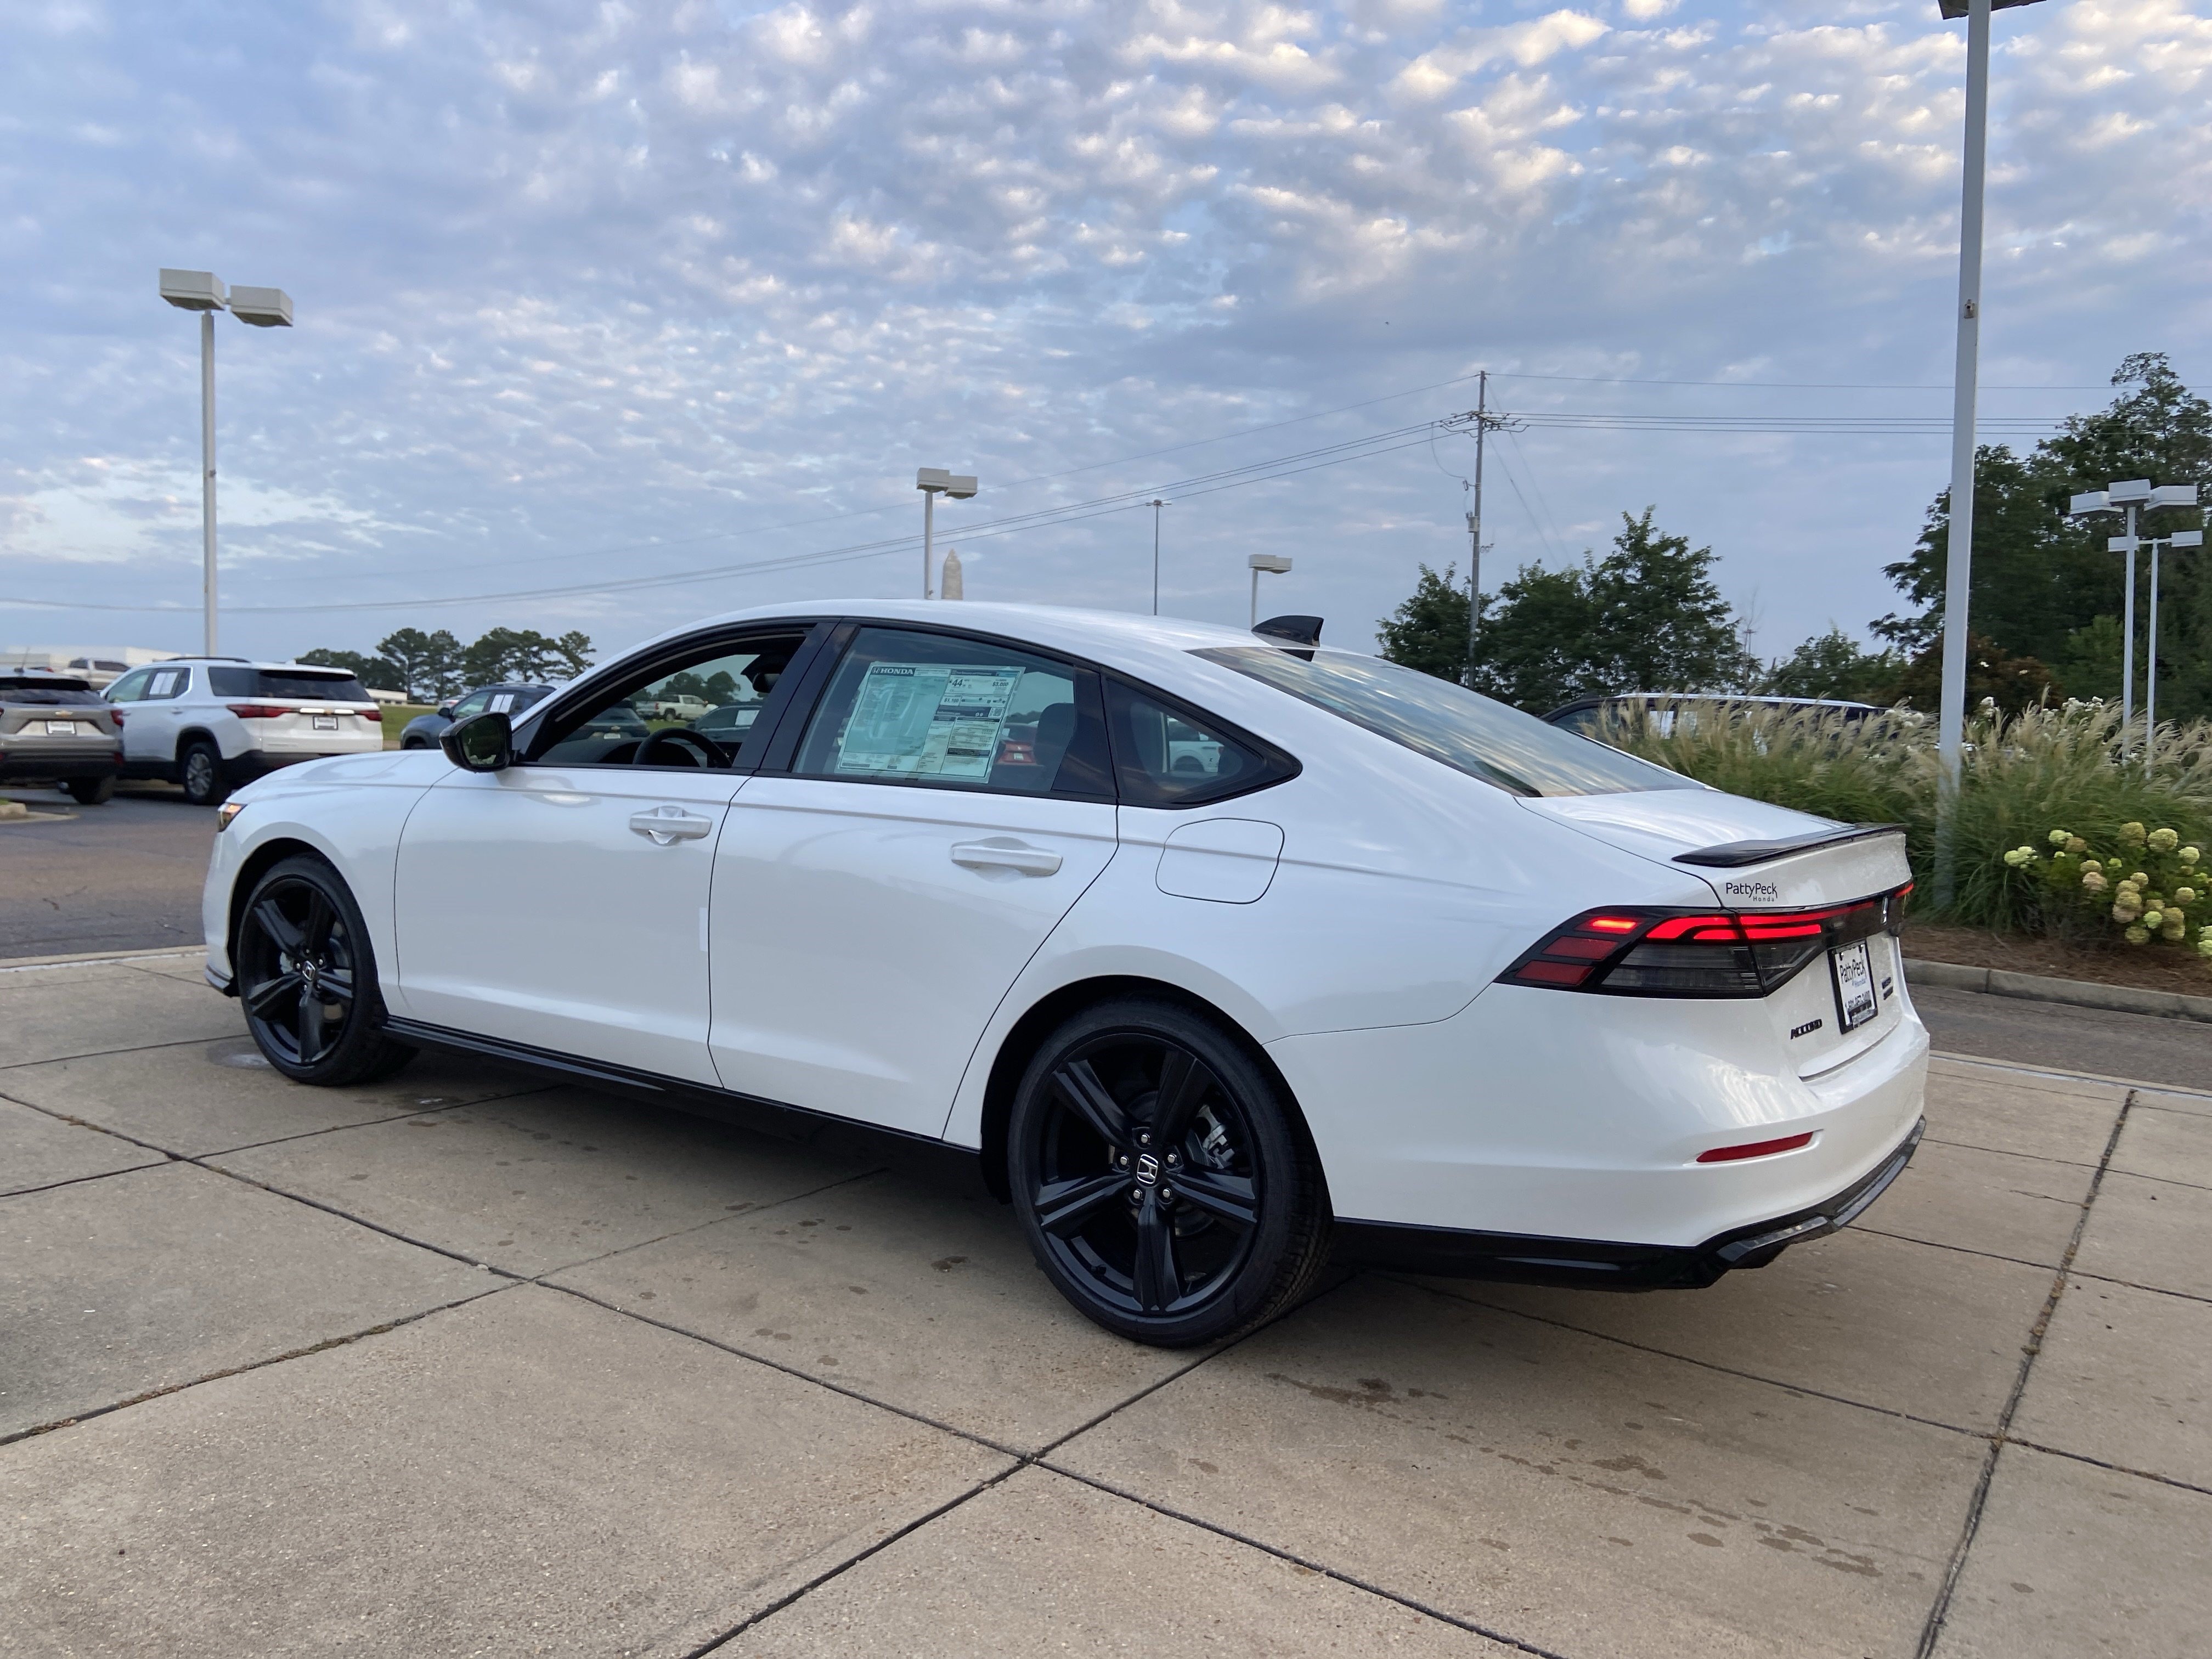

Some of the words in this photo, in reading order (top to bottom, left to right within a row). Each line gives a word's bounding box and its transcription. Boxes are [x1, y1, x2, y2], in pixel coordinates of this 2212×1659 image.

[952, 679, 963, 687] 44
[1726, 882, 1778, 899] PattyPeck
[1791, 1019, 1822, 1040] ACCORD
